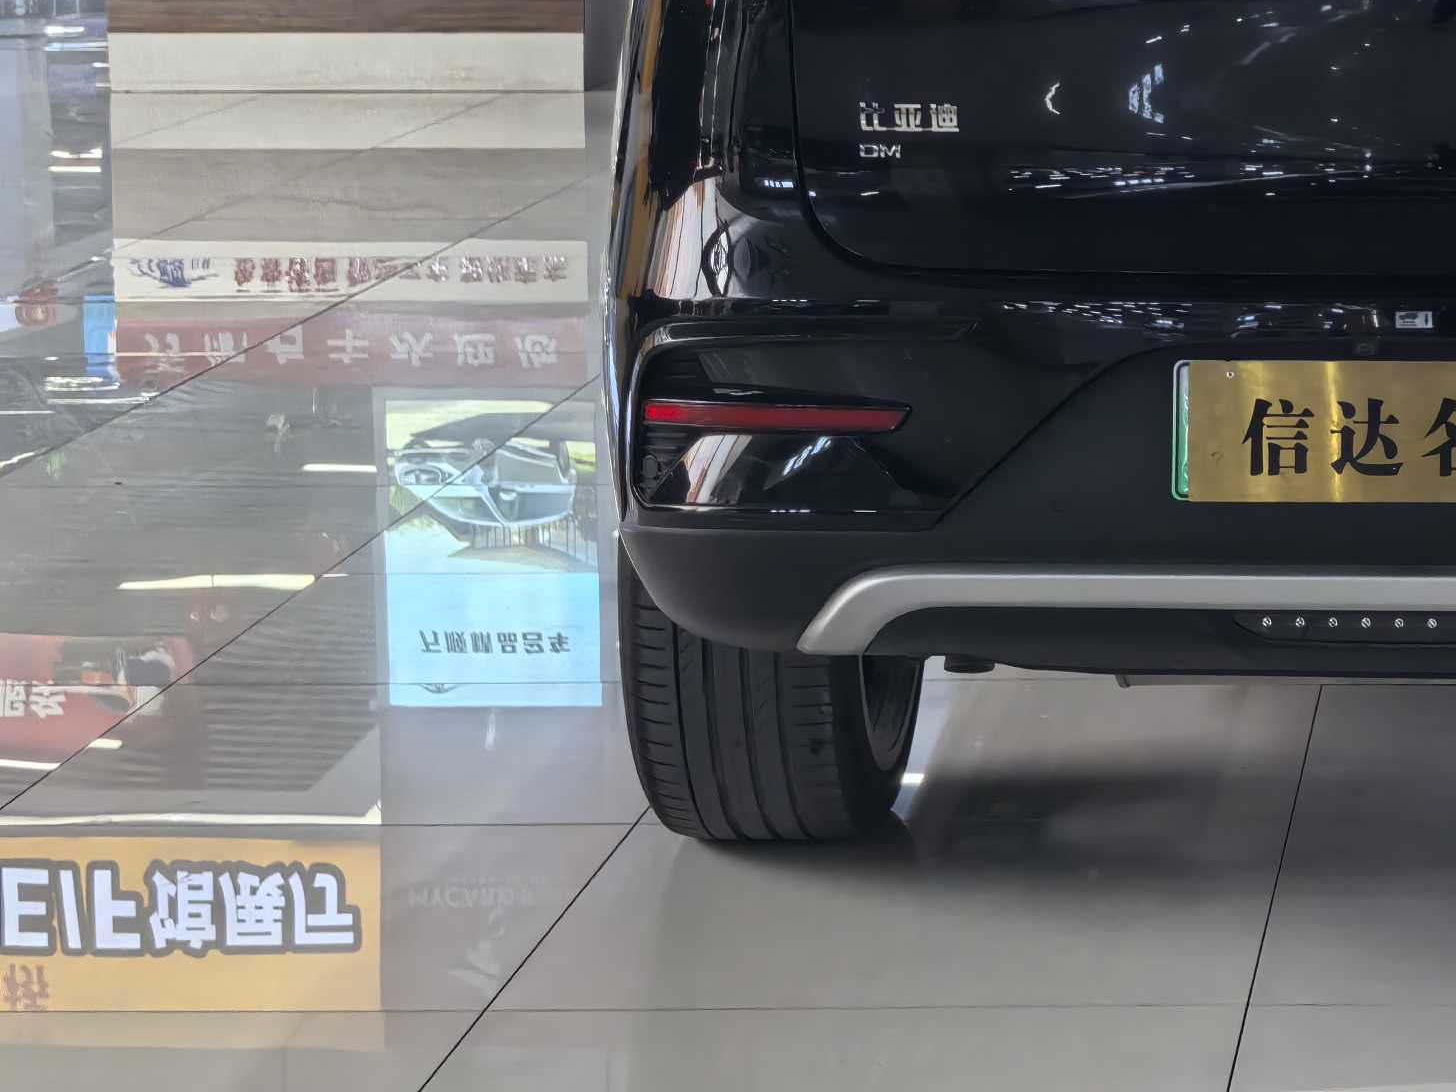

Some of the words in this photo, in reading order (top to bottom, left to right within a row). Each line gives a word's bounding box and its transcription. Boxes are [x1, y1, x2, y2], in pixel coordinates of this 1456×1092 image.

[860, 102, 960, 133] 比亚迪
[859, 144, 902, 158] DM
